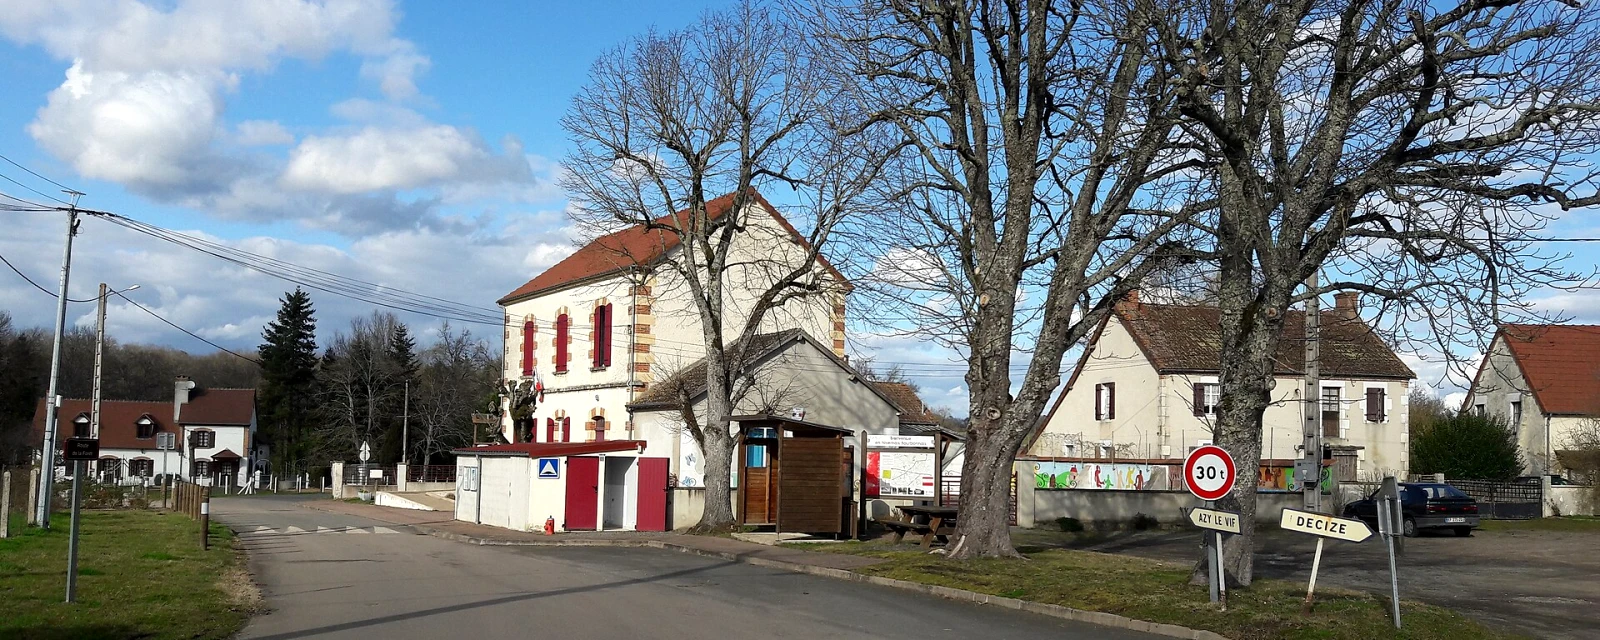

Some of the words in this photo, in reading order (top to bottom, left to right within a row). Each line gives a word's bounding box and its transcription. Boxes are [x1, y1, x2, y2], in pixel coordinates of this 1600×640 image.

[1196, 466, 1216, 480] 30
[1219, 469, 1225, 480] t
[1198, 513, 1212, 524] AZY
[1214, 515, 1223, 526] LE
[1225, 516, 1236, 528] VIF
[1296, 516, 1347, 535] DECIZE
